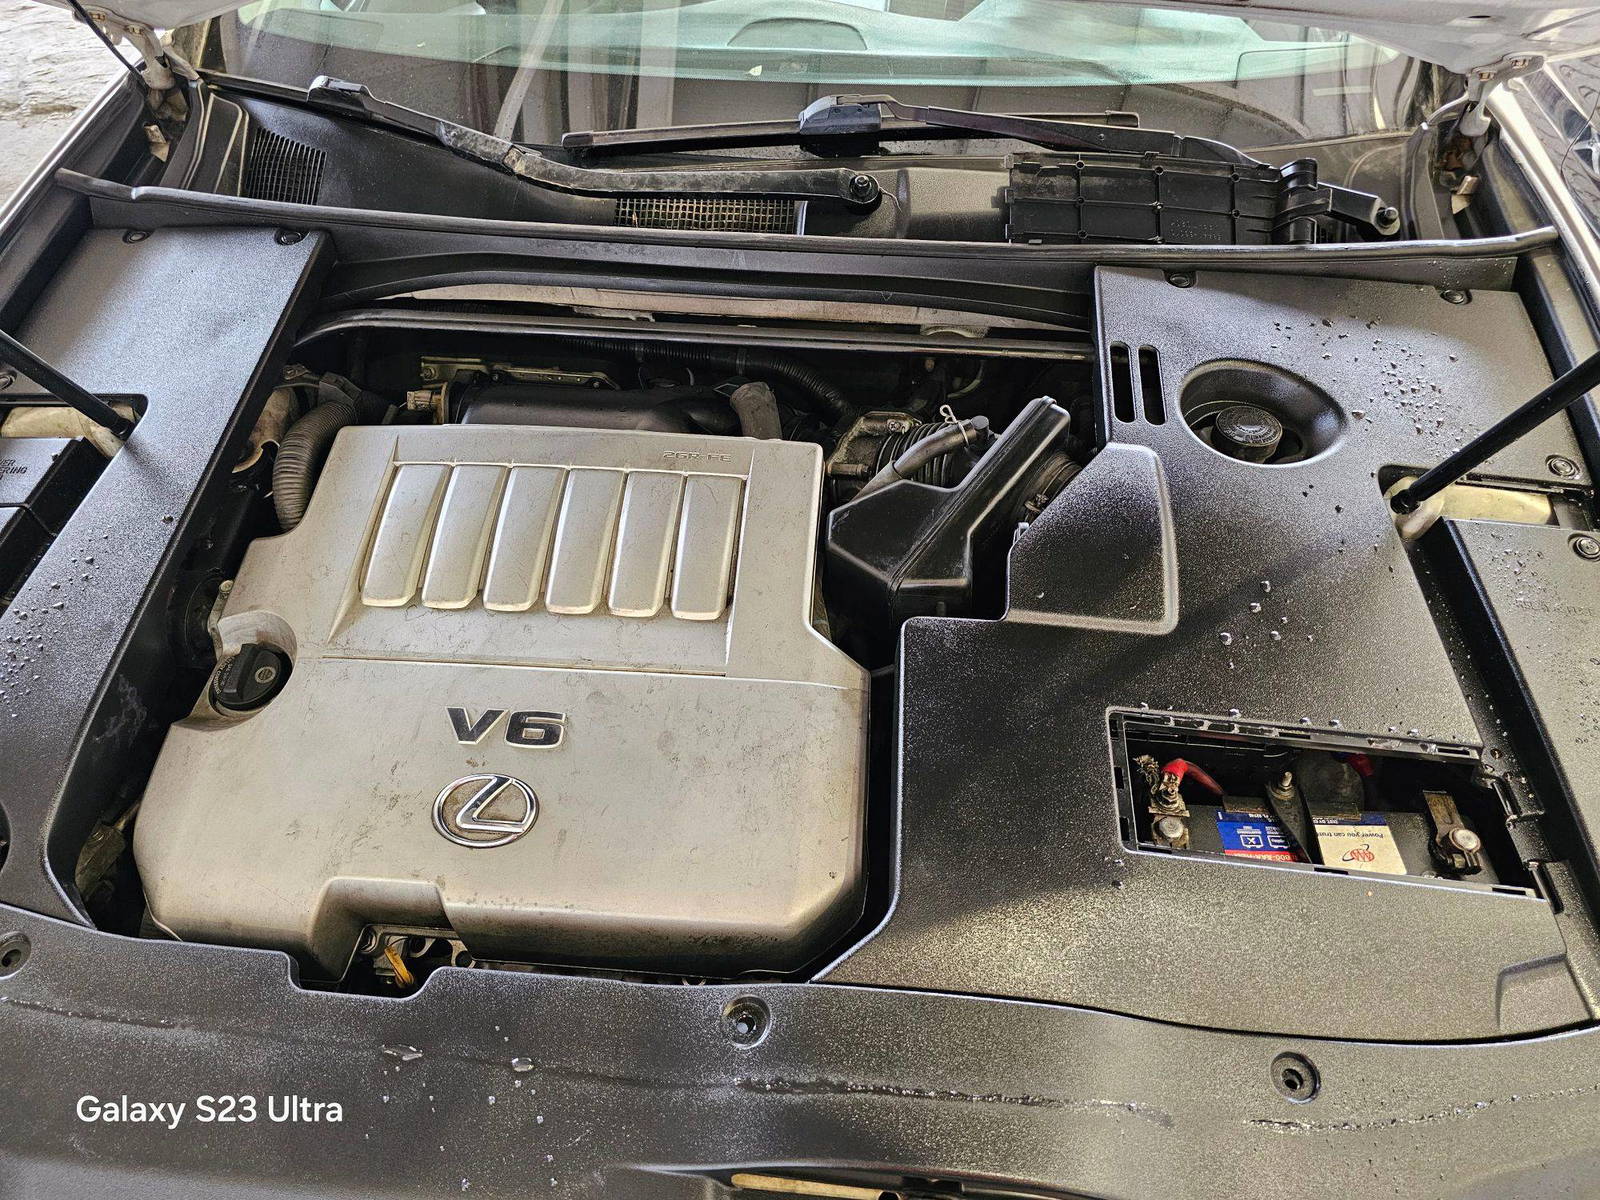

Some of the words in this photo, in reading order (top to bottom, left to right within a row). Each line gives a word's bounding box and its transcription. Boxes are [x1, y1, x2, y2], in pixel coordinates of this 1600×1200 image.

[446, 706, 567, 749] V6
[1347, 831, 1360, 839] you
[1360, 831, 1384, 839] Power
